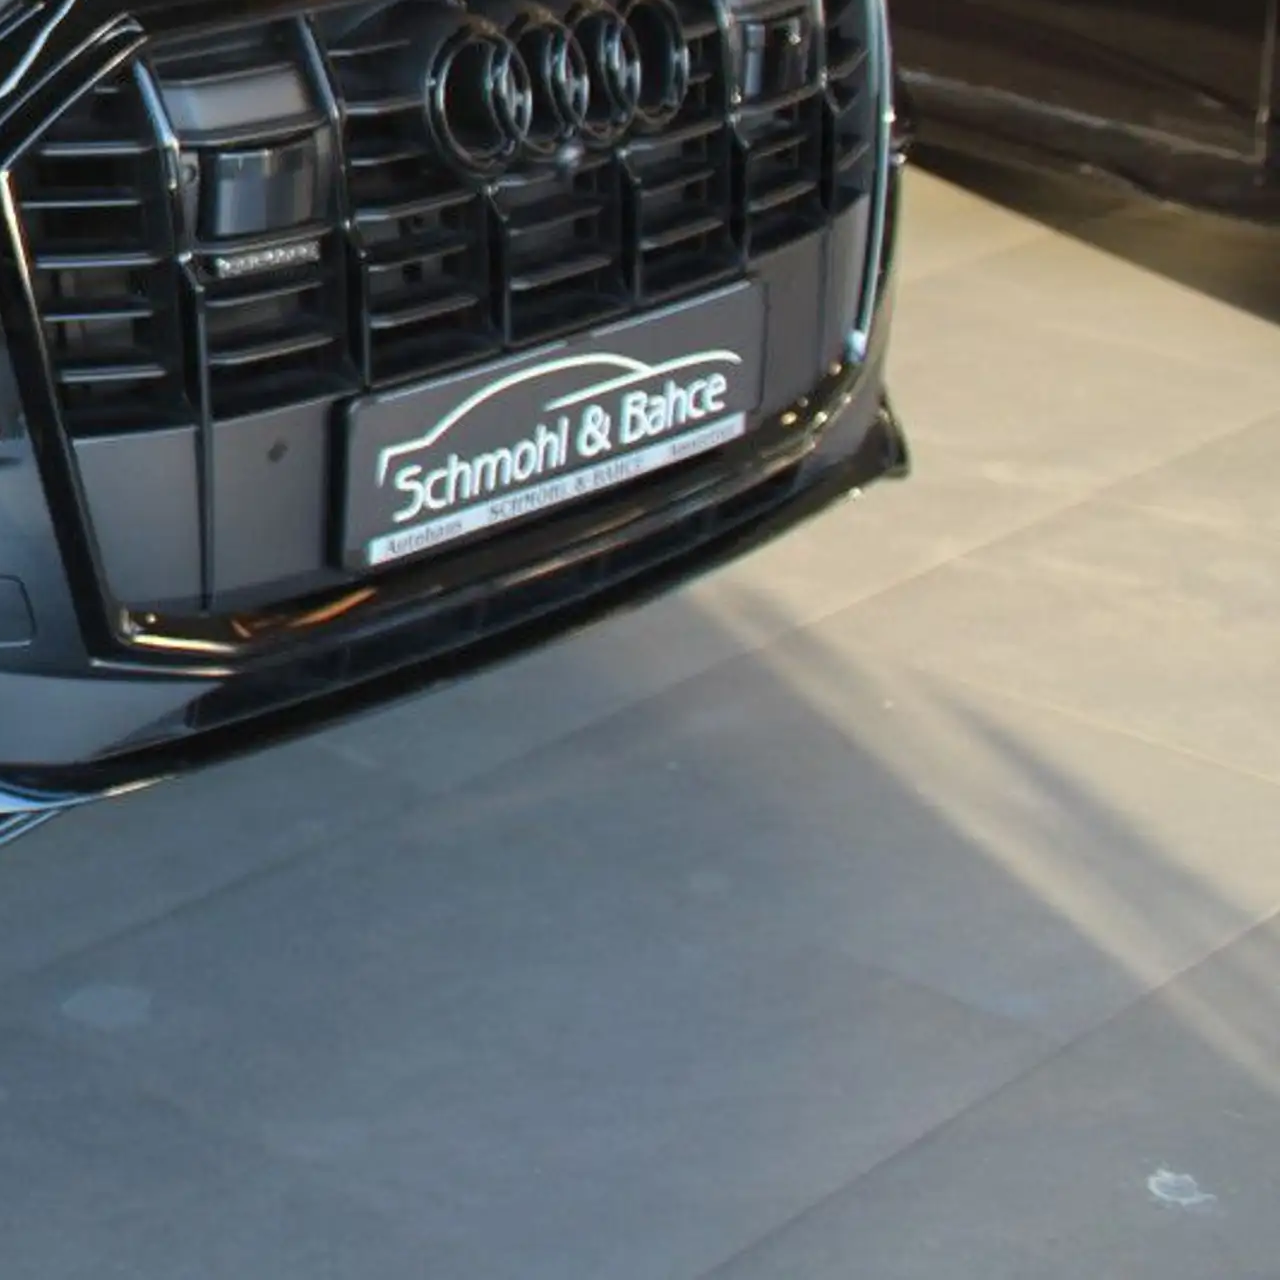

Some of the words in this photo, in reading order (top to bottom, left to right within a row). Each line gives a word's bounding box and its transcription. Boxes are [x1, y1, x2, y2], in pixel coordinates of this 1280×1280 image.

[393, 415, 569, 523] Schmohl
[576, 403, 612, 458] &
[619, 372, 727, 445] Bahce
